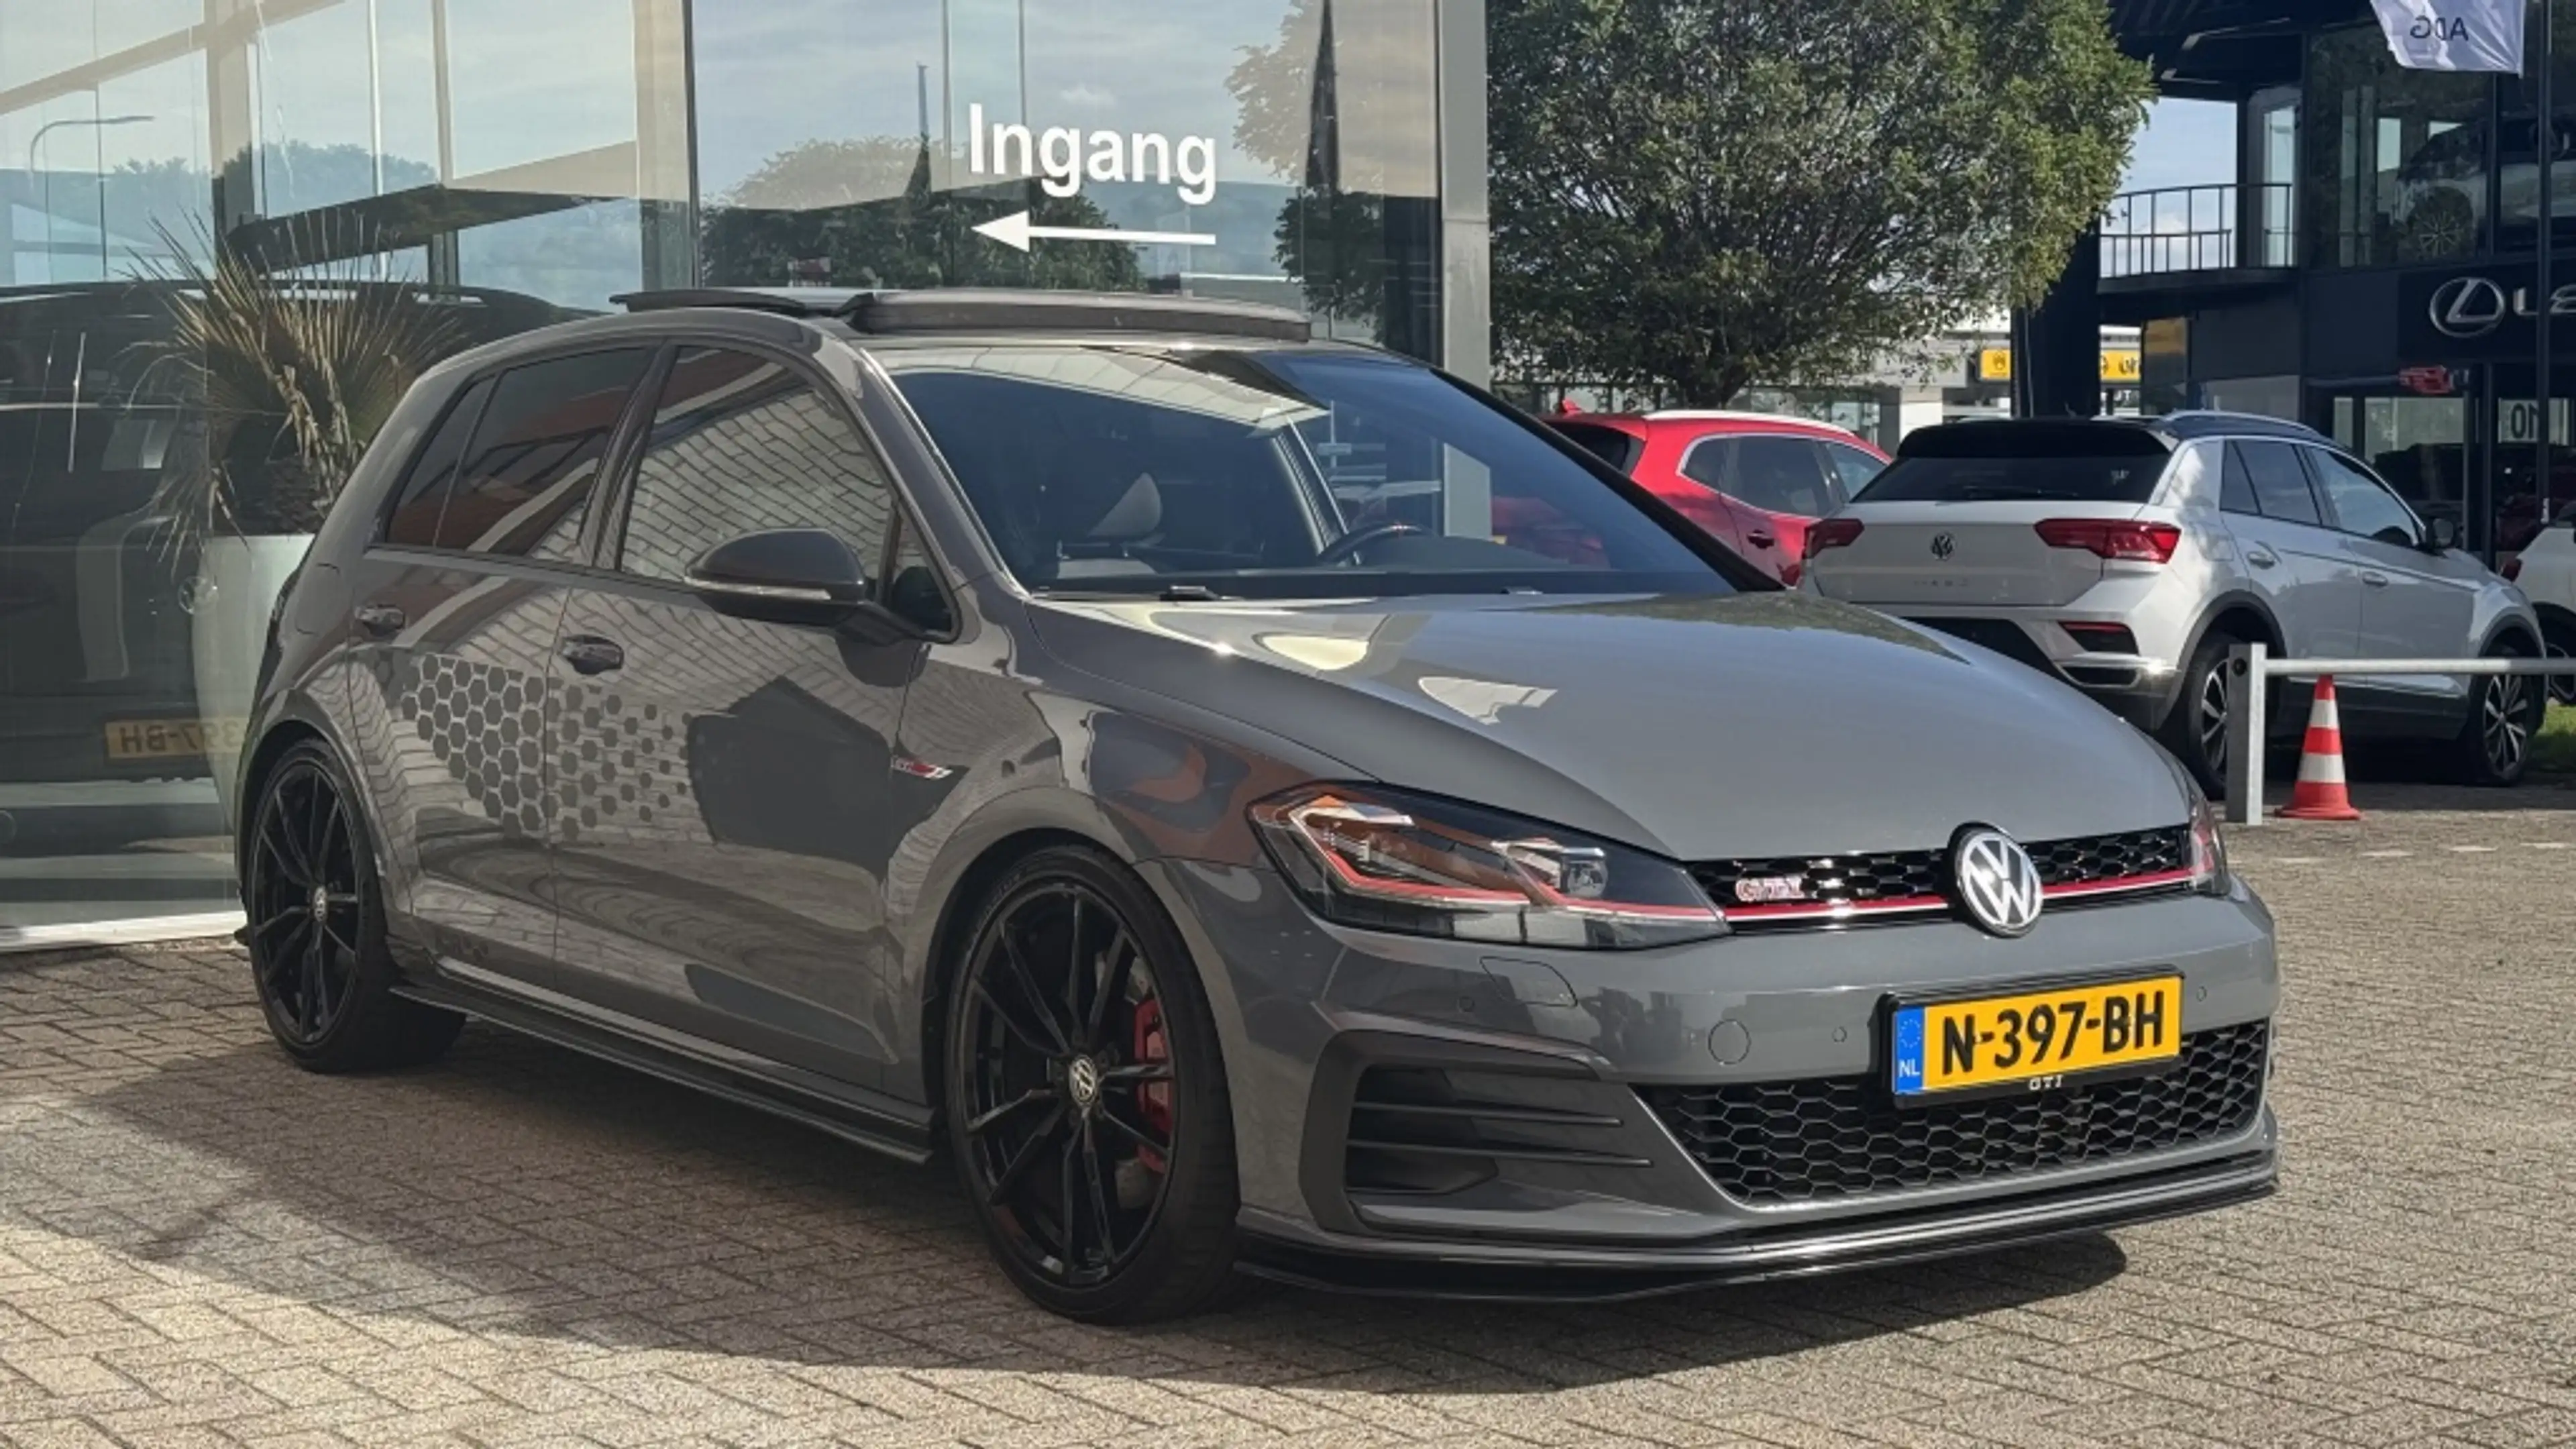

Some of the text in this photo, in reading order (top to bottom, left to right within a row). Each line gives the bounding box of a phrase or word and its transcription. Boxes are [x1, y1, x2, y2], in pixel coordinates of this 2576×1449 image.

[969, 103, 1216, 205] Ingang
[1941, 990, 2165, 1076] N-397-BH
[1898, 1059, 1921, 1077] NL
[2028, 1074, 2064, 1091] GTI
